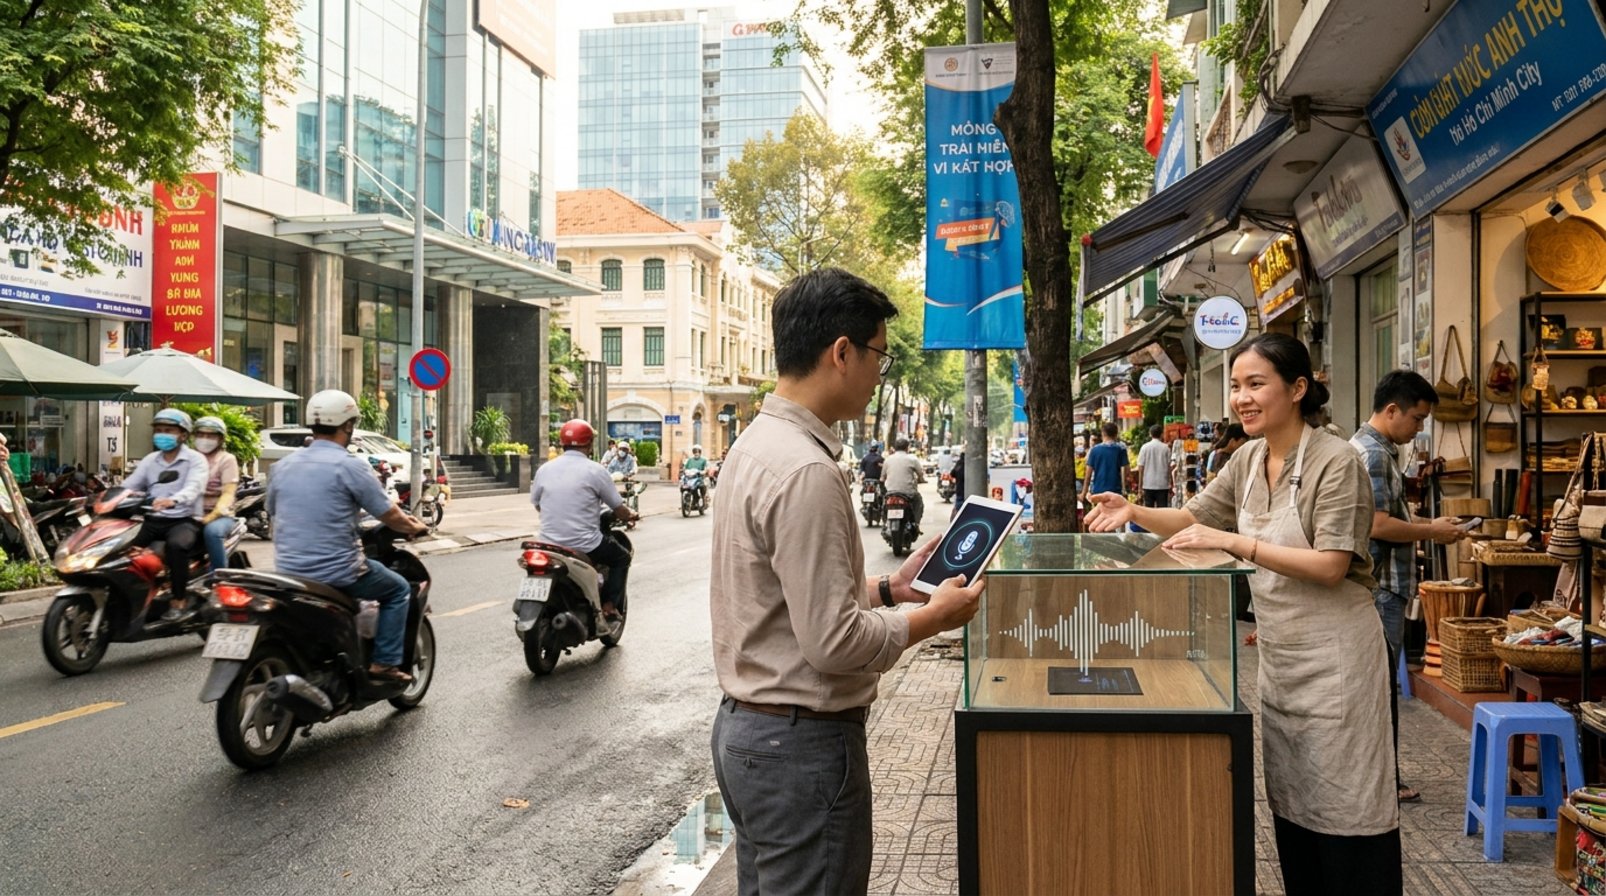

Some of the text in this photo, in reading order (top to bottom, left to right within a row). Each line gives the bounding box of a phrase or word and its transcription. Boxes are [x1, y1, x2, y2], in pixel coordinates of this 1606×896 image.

[1484, 10, 1526, 71] ANH
[1490, 77, 1519, 113] Minh
[1516, 60, 1542, 90] City
[933, 161, 948, 175] VI
